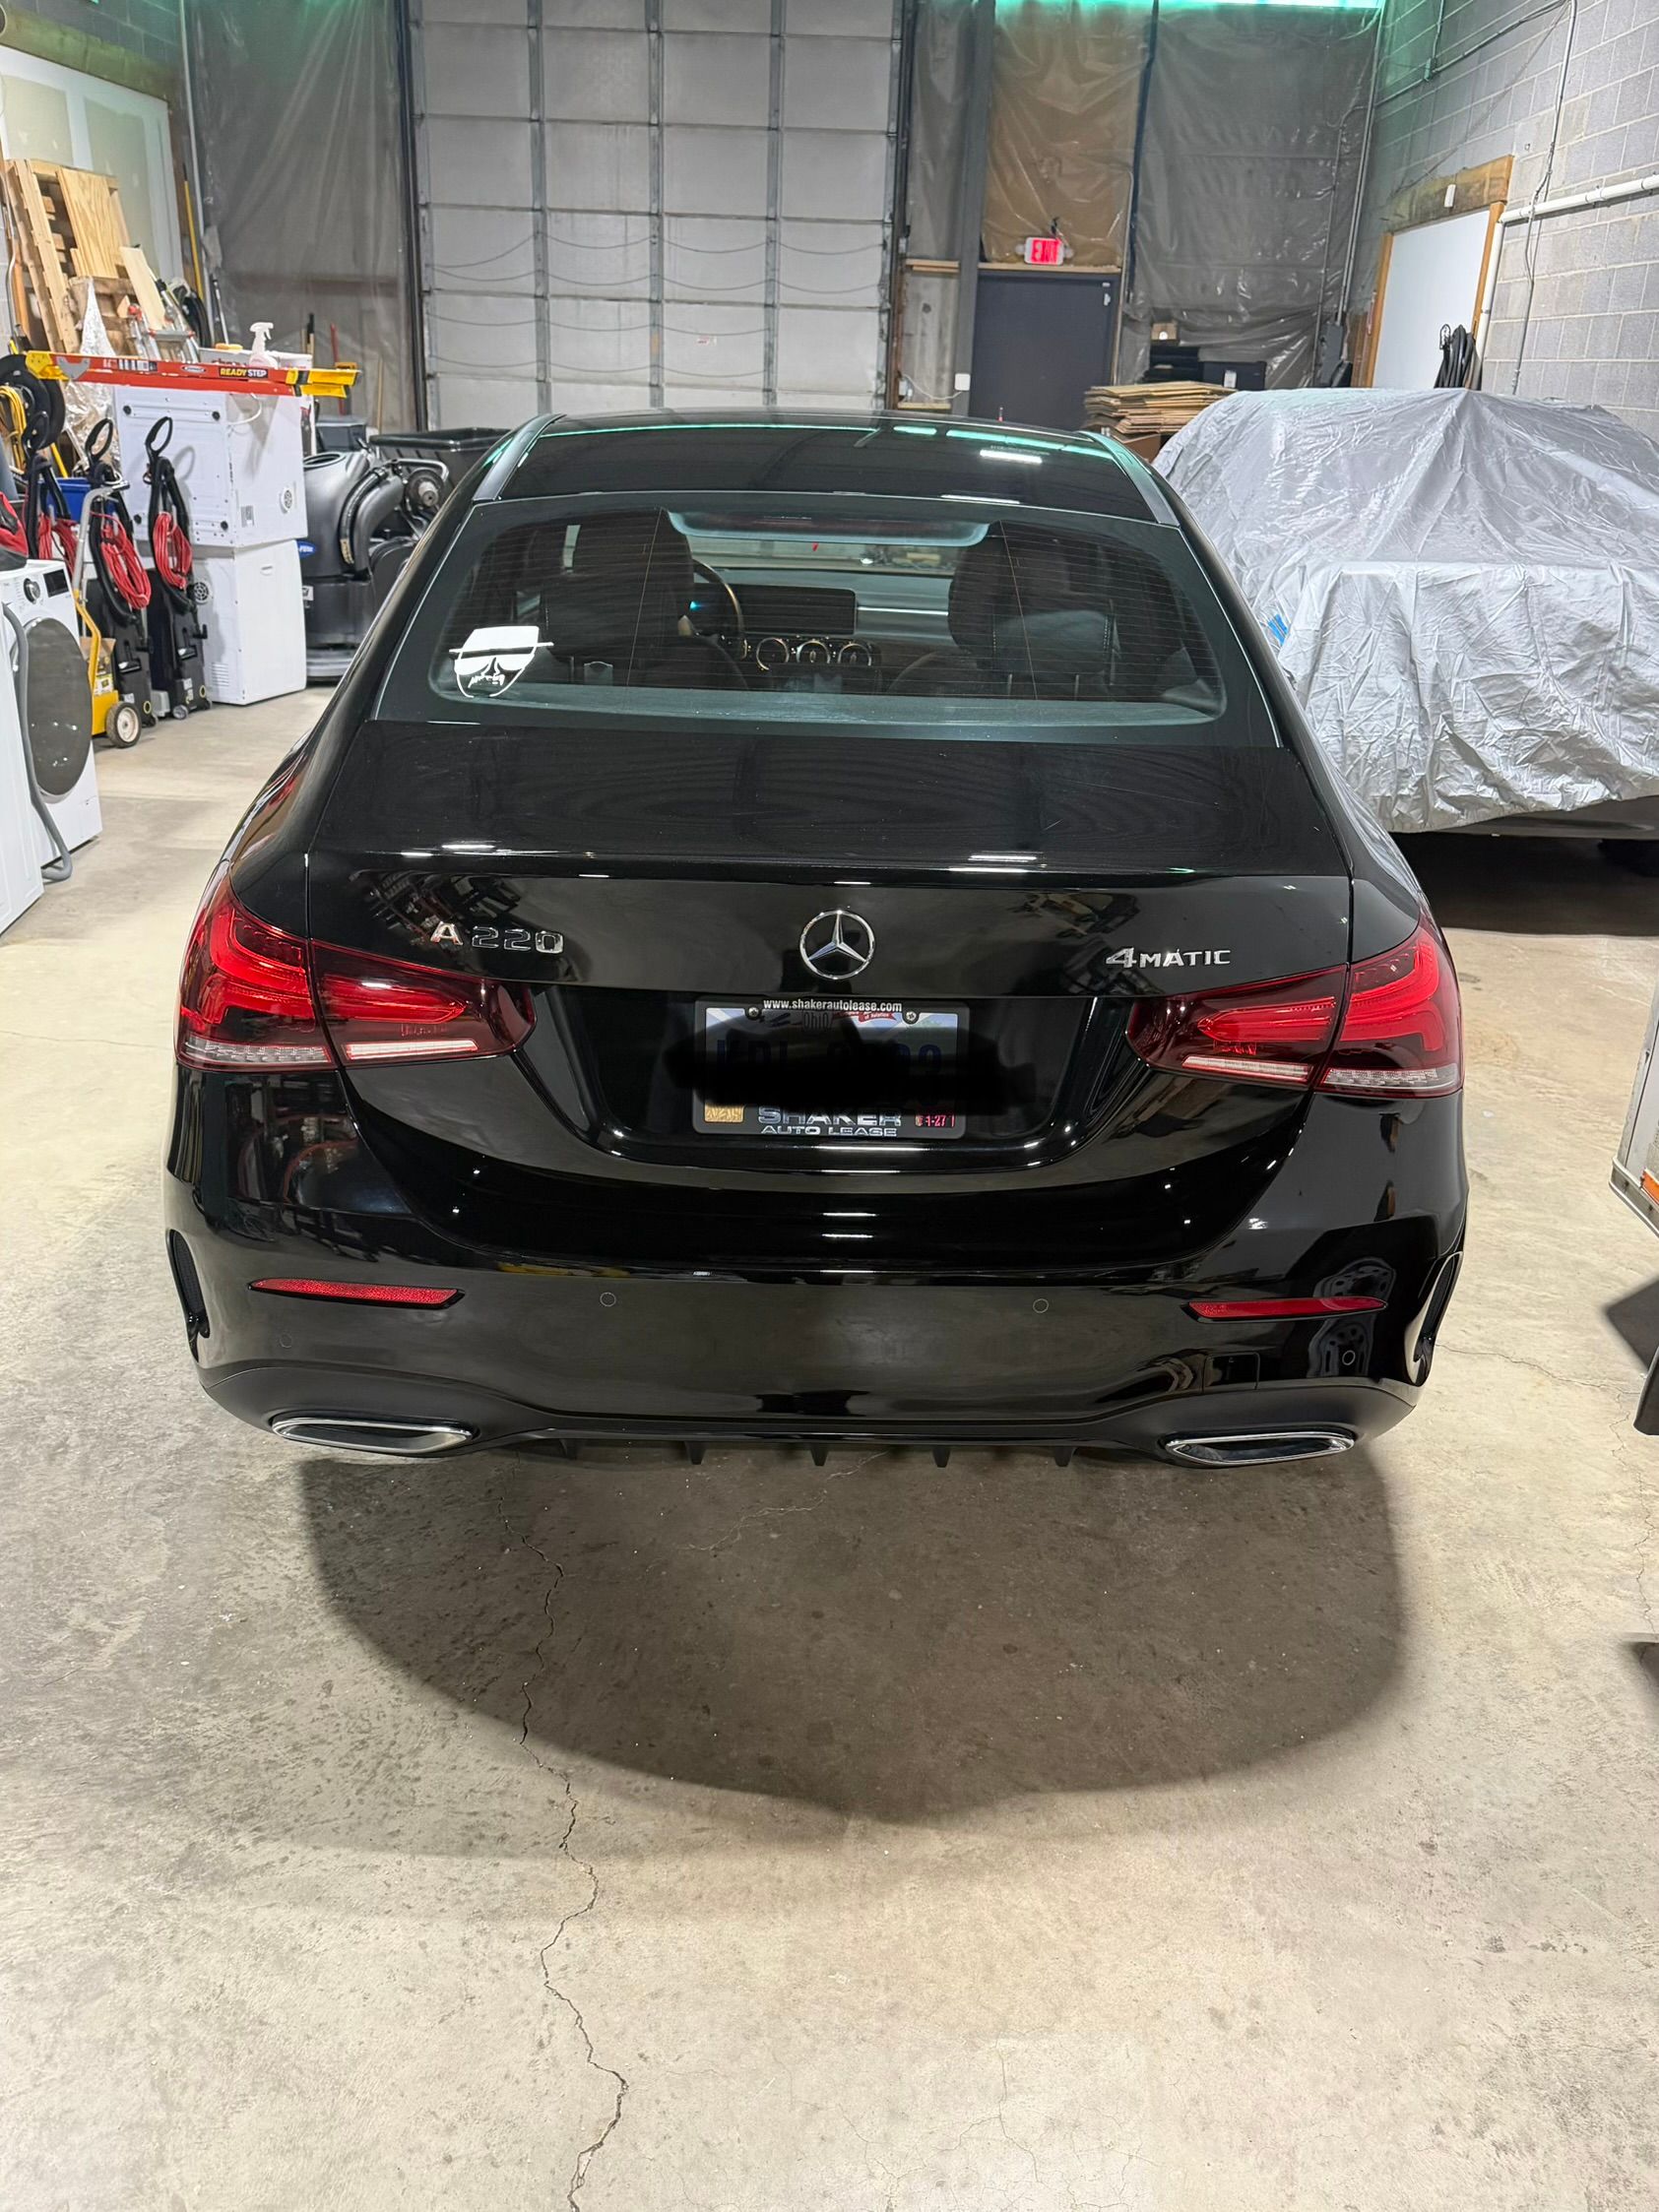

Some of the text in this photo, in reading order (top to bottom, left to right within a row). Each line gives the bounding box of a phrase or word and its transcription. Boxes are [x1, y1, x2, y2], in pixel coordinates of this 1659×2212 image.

[220, 367, 268, 378] READY STEP
[430, 921, 564, 954] A 220
[1106, 947, 1231, 969] 4MATIC
[763, 998, 903, 1012] www.shakerautolease.com
[757, 1106, 902, 1126] SHAKER
[761, 1125, 897, 1137] AUTO LEASE
